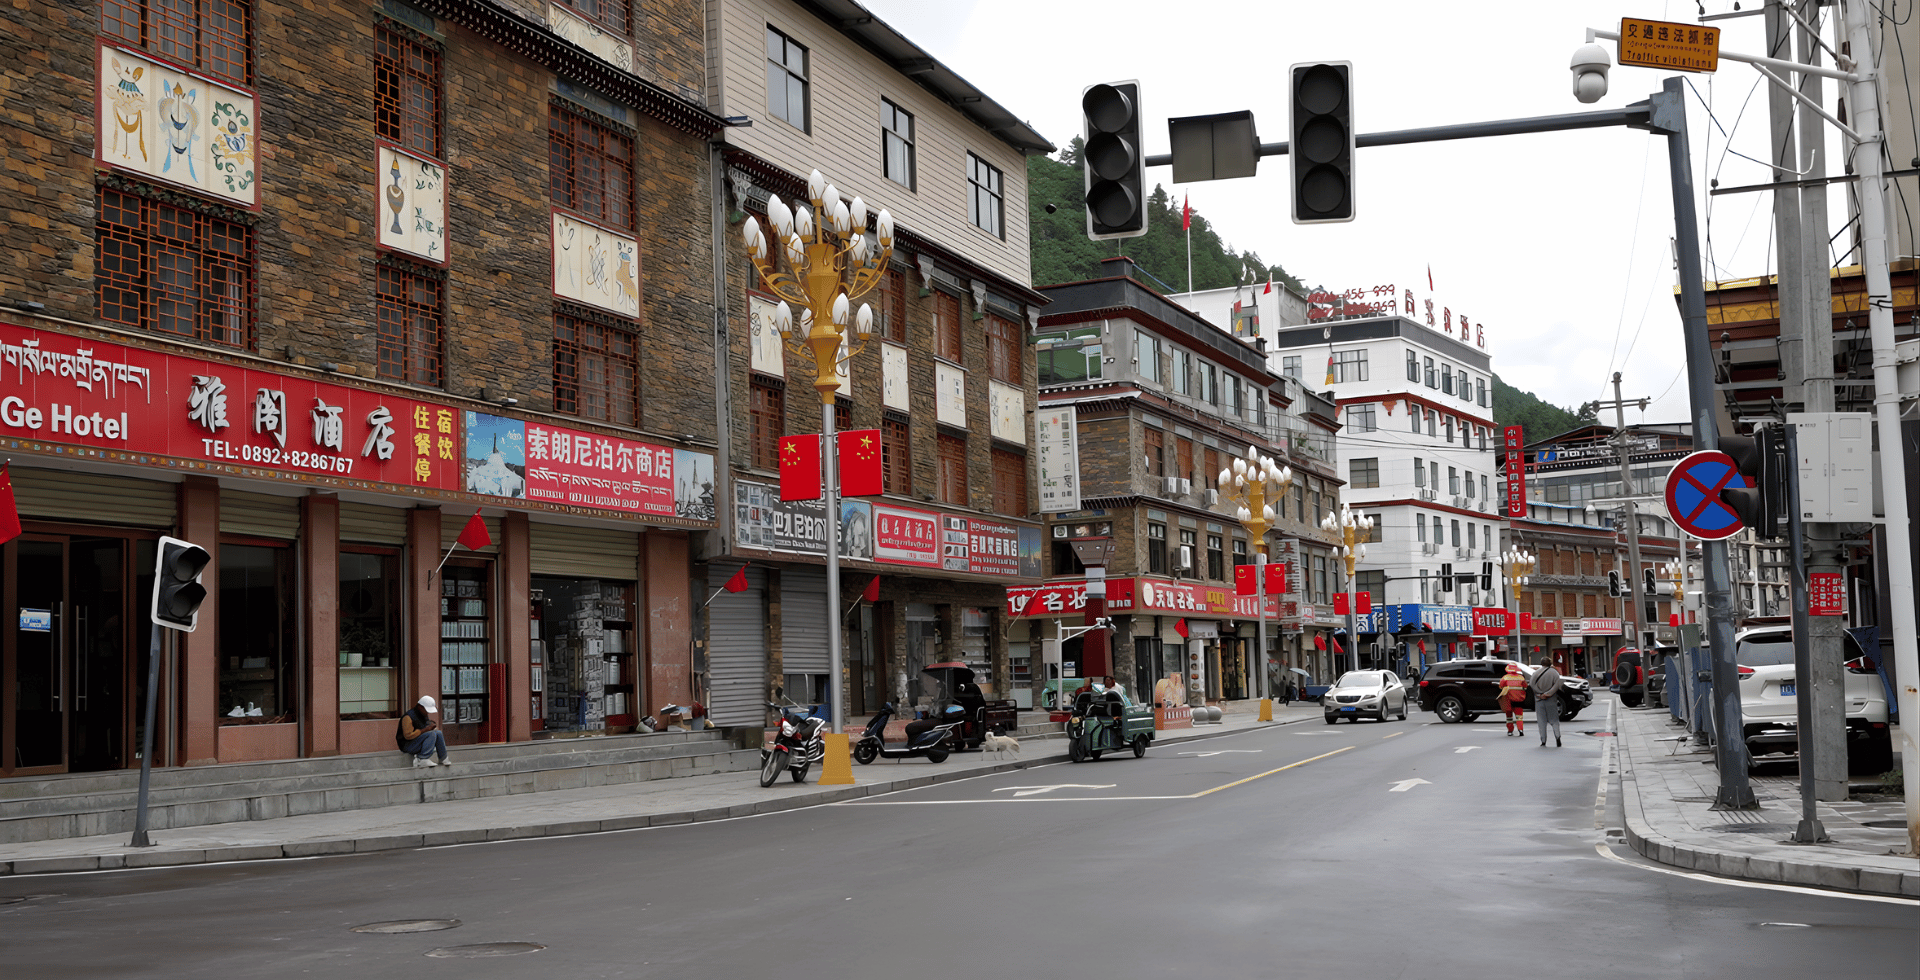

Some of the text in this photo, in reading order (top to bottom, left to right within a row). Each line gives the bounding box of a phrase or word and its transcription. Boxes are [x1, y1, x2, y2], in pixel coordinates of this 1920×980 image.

[1628, 23, 1714, 46] 交通违法抓拍
[0, 395, 128, 441] Ge Hotel
[187, 374, 396, 460] 雅阁酒店
[527, 426, 673, 480] 索朗尼泊尔商店
